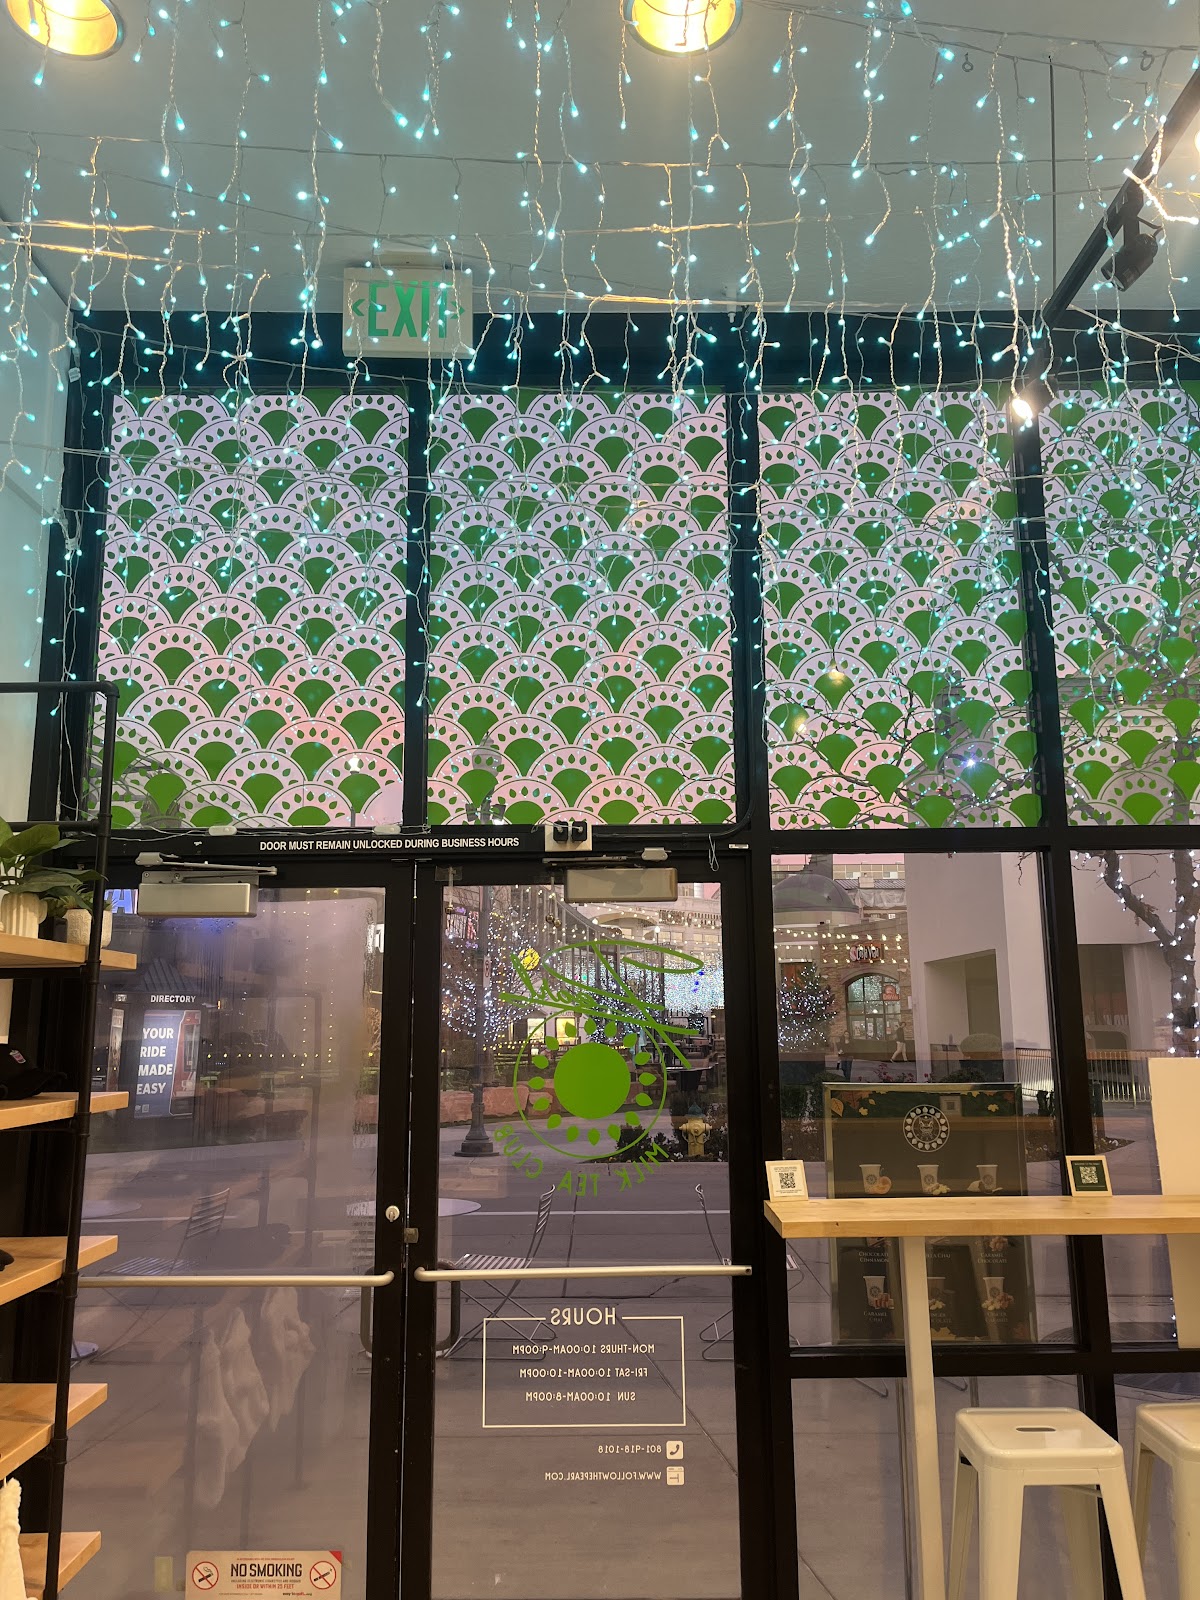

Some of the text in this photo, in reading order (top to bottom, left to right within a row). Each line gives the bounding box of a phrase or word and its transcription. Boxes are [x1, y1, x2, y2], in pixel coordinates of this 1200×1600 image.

[368, 280, 453, 338] EXIT
[260, 837, 520, 850] DOOR MUST REMAIN UNLOCKED DURING BUSINESS HOURS
[150, 994, 196, 1003] DIRECTORY
[142, 1028, 174, 1039] YOUR
[140, 1046, 166, 1058] RIDE
[138, 1064, 173, 1076] MADE
[136, 1082, 166, 1095] EASY
[230, 1563, 303, 1577] NO SMOKING
